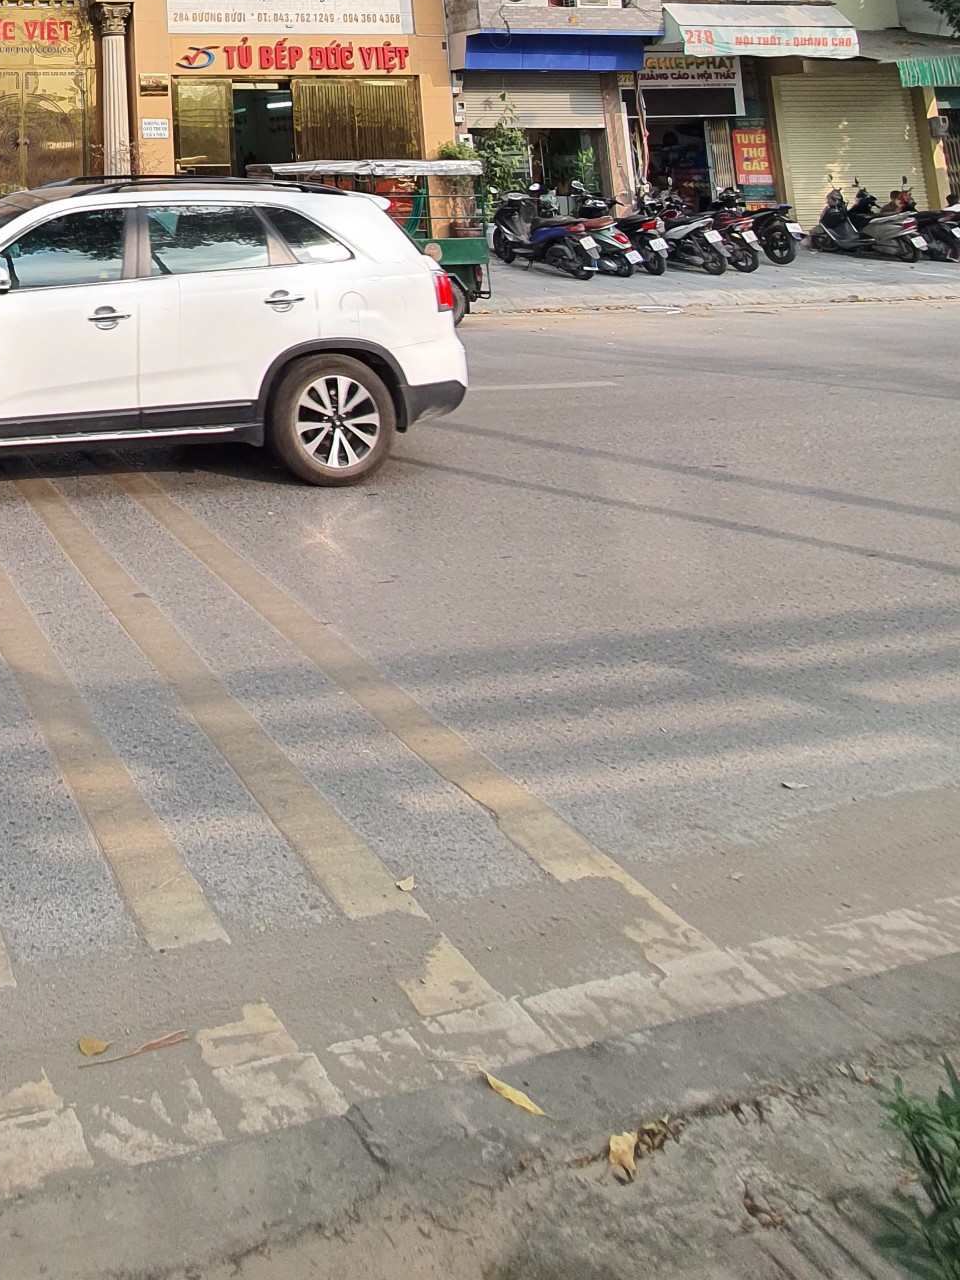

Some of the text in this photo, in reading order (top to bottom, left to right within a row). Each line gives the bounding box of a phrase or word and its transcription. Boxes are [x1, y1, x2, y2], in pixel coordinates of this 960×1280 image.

[173, 12, 189, 23] 284
[295, 12, 311, 23] 762
[313, 13, 334, 23] 1249
[343, 13, 359, 23] 094
[361, 13, 377, 23] 360
[379, 13, 401, 24] 4368
[24, 17, 73, 46] VIỆT
[684, 29, 715, 45] 278
[223, 36, 253, 70] TỦ
[258, 37, 304, 70] BẾP
[309, 39, 355, 71] ĐỨC
[359, 40, 409, 73] VIỆT
